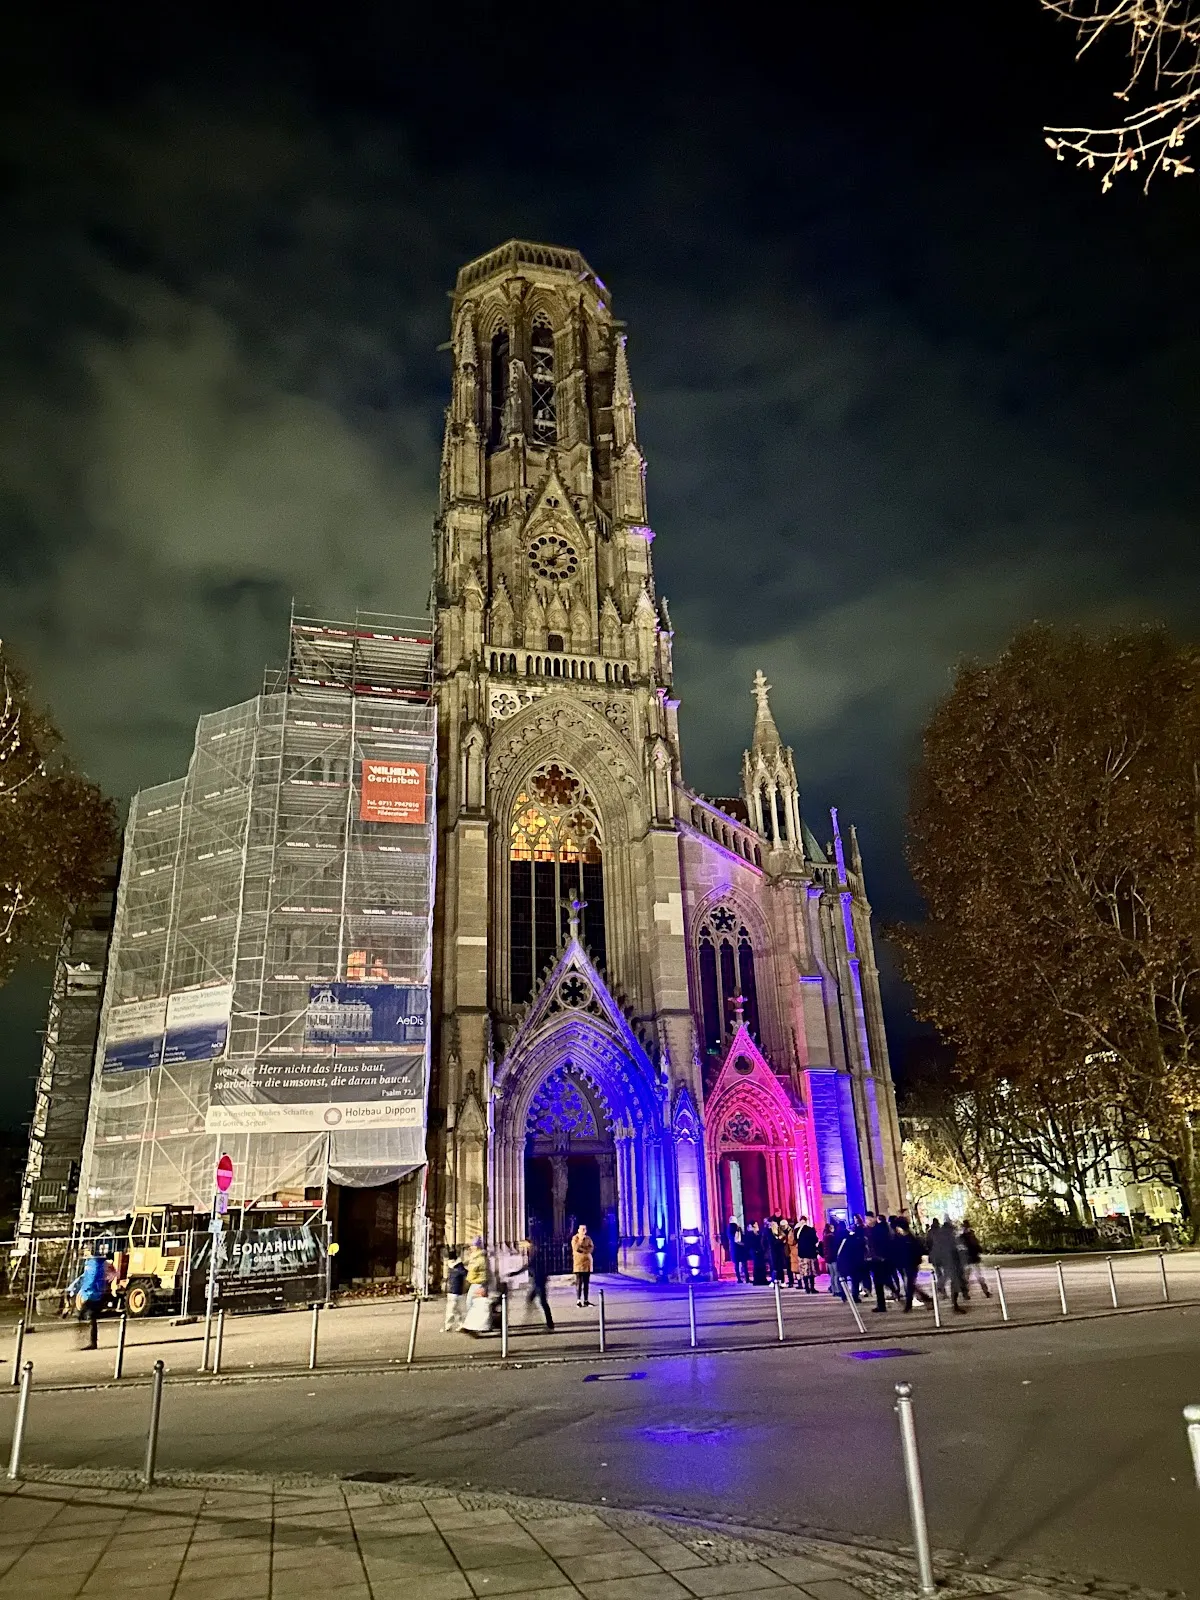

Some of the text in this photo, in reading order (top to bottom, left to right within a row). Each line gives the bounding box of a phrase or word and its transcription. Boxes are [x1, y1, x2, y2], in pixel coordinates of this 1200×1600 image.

[369, 766, 420, 777] WILHELM
[367, 774, 420, 785] Gerüstbau
[396, 1016, 424, 1025] AeDis
[216, 1063, 386, 1076] Wenn der Herr nicht das Haus baut,
[213, 1075, 411, 1090] so arbeiten die umsonst, die daran bauen.
[381, 1089, 401, 1097] Psalm
[283, 1107, 314, 1116] Schaffen
[345, 1106, 416, 1117] Holzbau Dippon
[232, 1239, 309, 1256] EONARIUM
